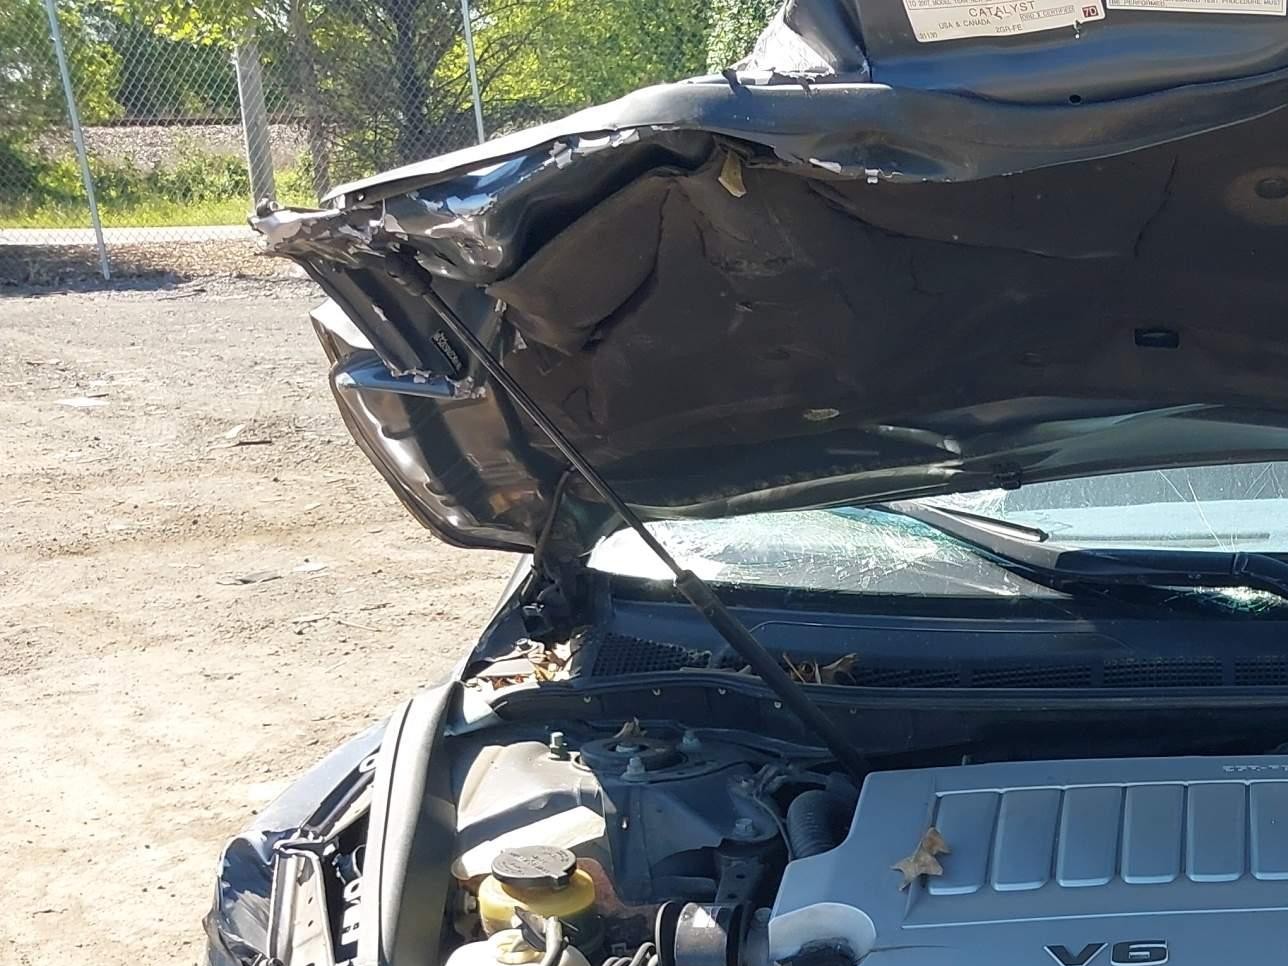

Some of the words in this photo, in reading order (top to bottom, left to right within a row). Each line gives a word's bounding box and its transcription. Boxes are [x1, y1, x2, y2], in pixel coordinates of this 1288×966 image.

[968, 1, 1036, 17] CATALYST
[1083, 6, 1097, 18] 7D
[963, 19, 991, 27] CANADA
